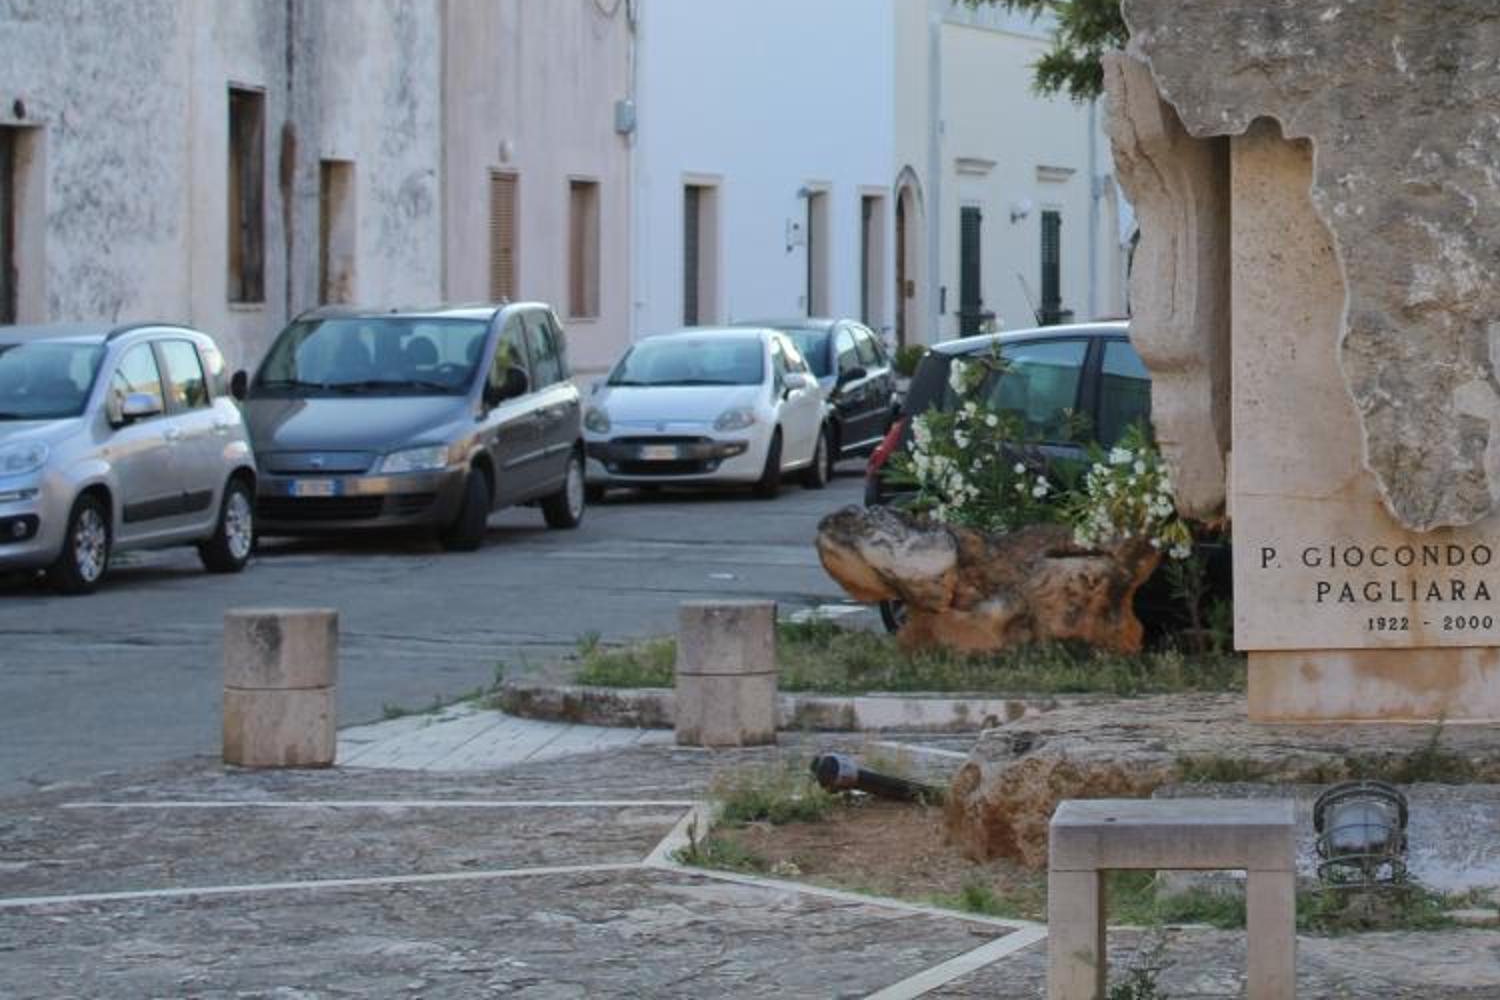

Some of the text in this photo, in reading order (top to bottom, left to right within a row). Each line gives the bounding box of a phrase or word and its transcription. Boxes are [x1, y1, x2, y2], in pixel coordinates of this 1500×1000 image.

[1301, 544, 1492, 569] GIOCONDO
[1316, 580, 1492, 603] PAGLIARA
[1367, 616, 1409, 631] 1922
[1443, 615, 1493, 631] 2000
